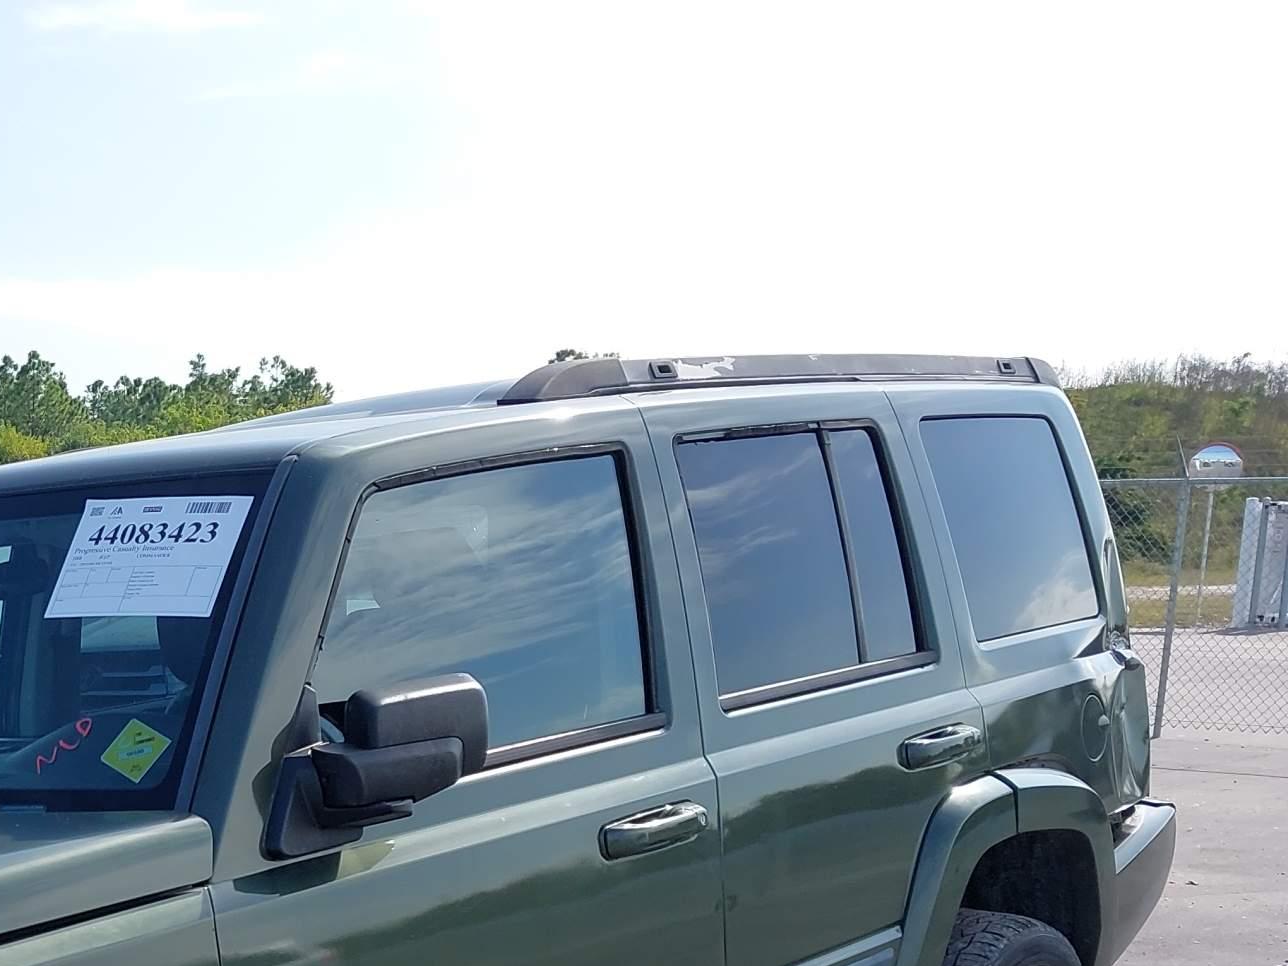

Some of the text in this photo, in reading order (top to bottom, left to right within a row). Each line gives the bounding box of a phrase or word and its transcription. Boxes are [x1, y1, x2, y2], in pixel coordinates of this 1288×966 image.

[88, 521, 220, 546] 44083423
[74, 543, 175, 556] Progressive Casualty Insurance
